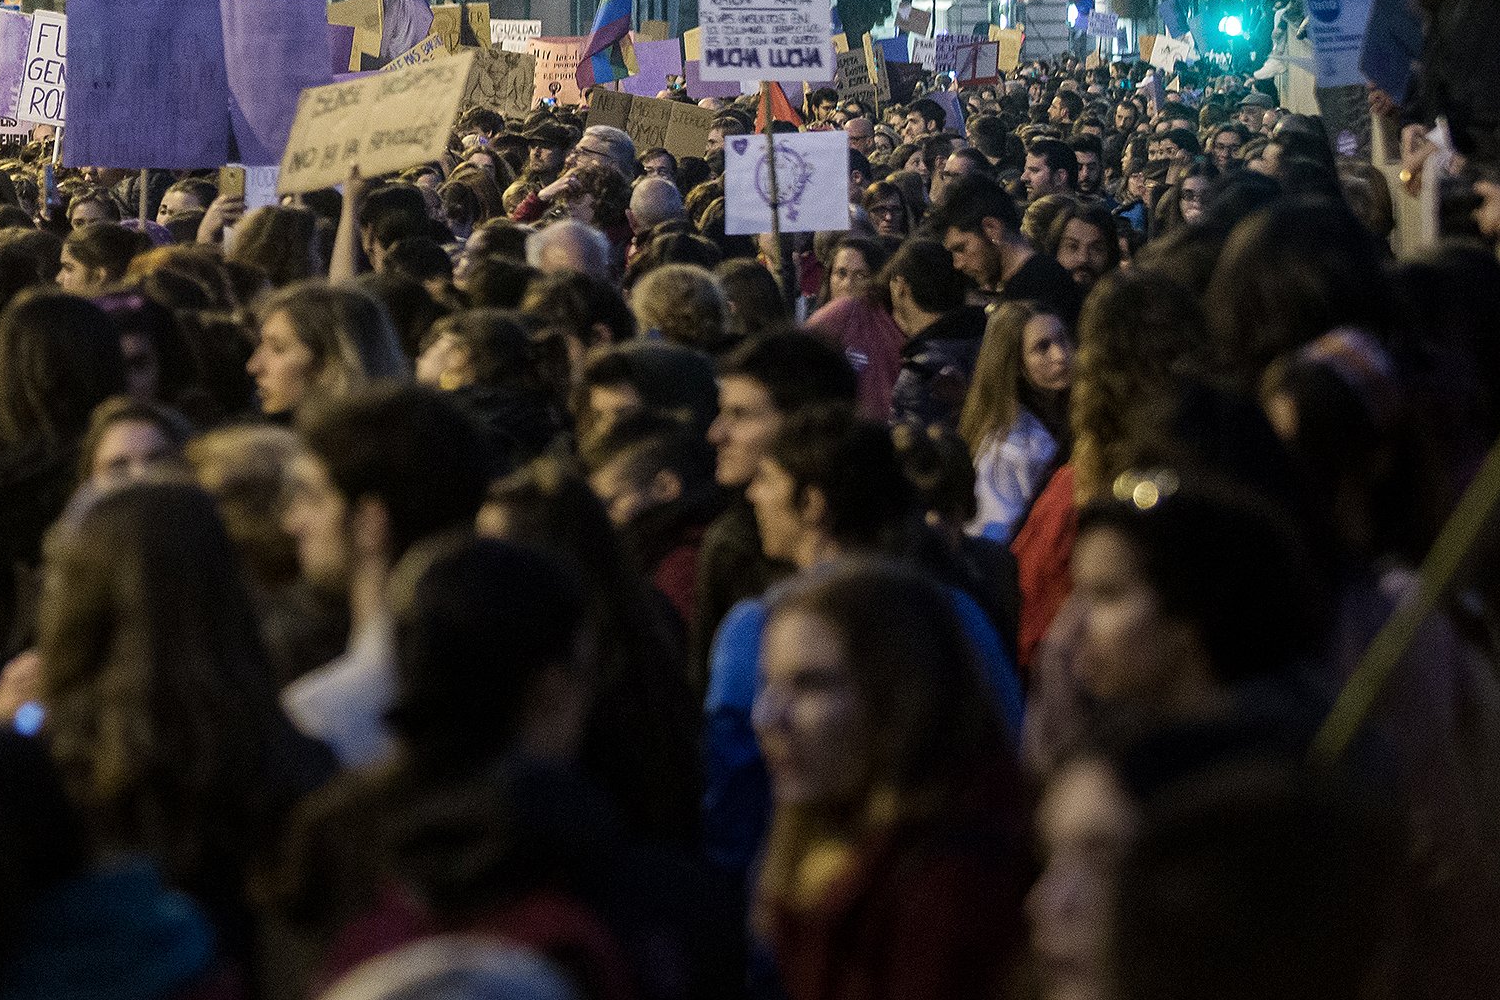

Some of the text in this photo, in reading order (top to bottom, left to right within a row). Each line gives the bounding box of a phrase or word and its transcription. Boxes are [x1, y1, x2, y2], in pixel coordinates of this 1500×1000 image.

[36, 22, 67, 59] FU
[491, 22, 541, 36] IGUALDAD
[27, 57, 67, 85] GEN
[706, 47, 823, 68] MUCHA LUCHA
[28, 86, 66, 122] ROL
